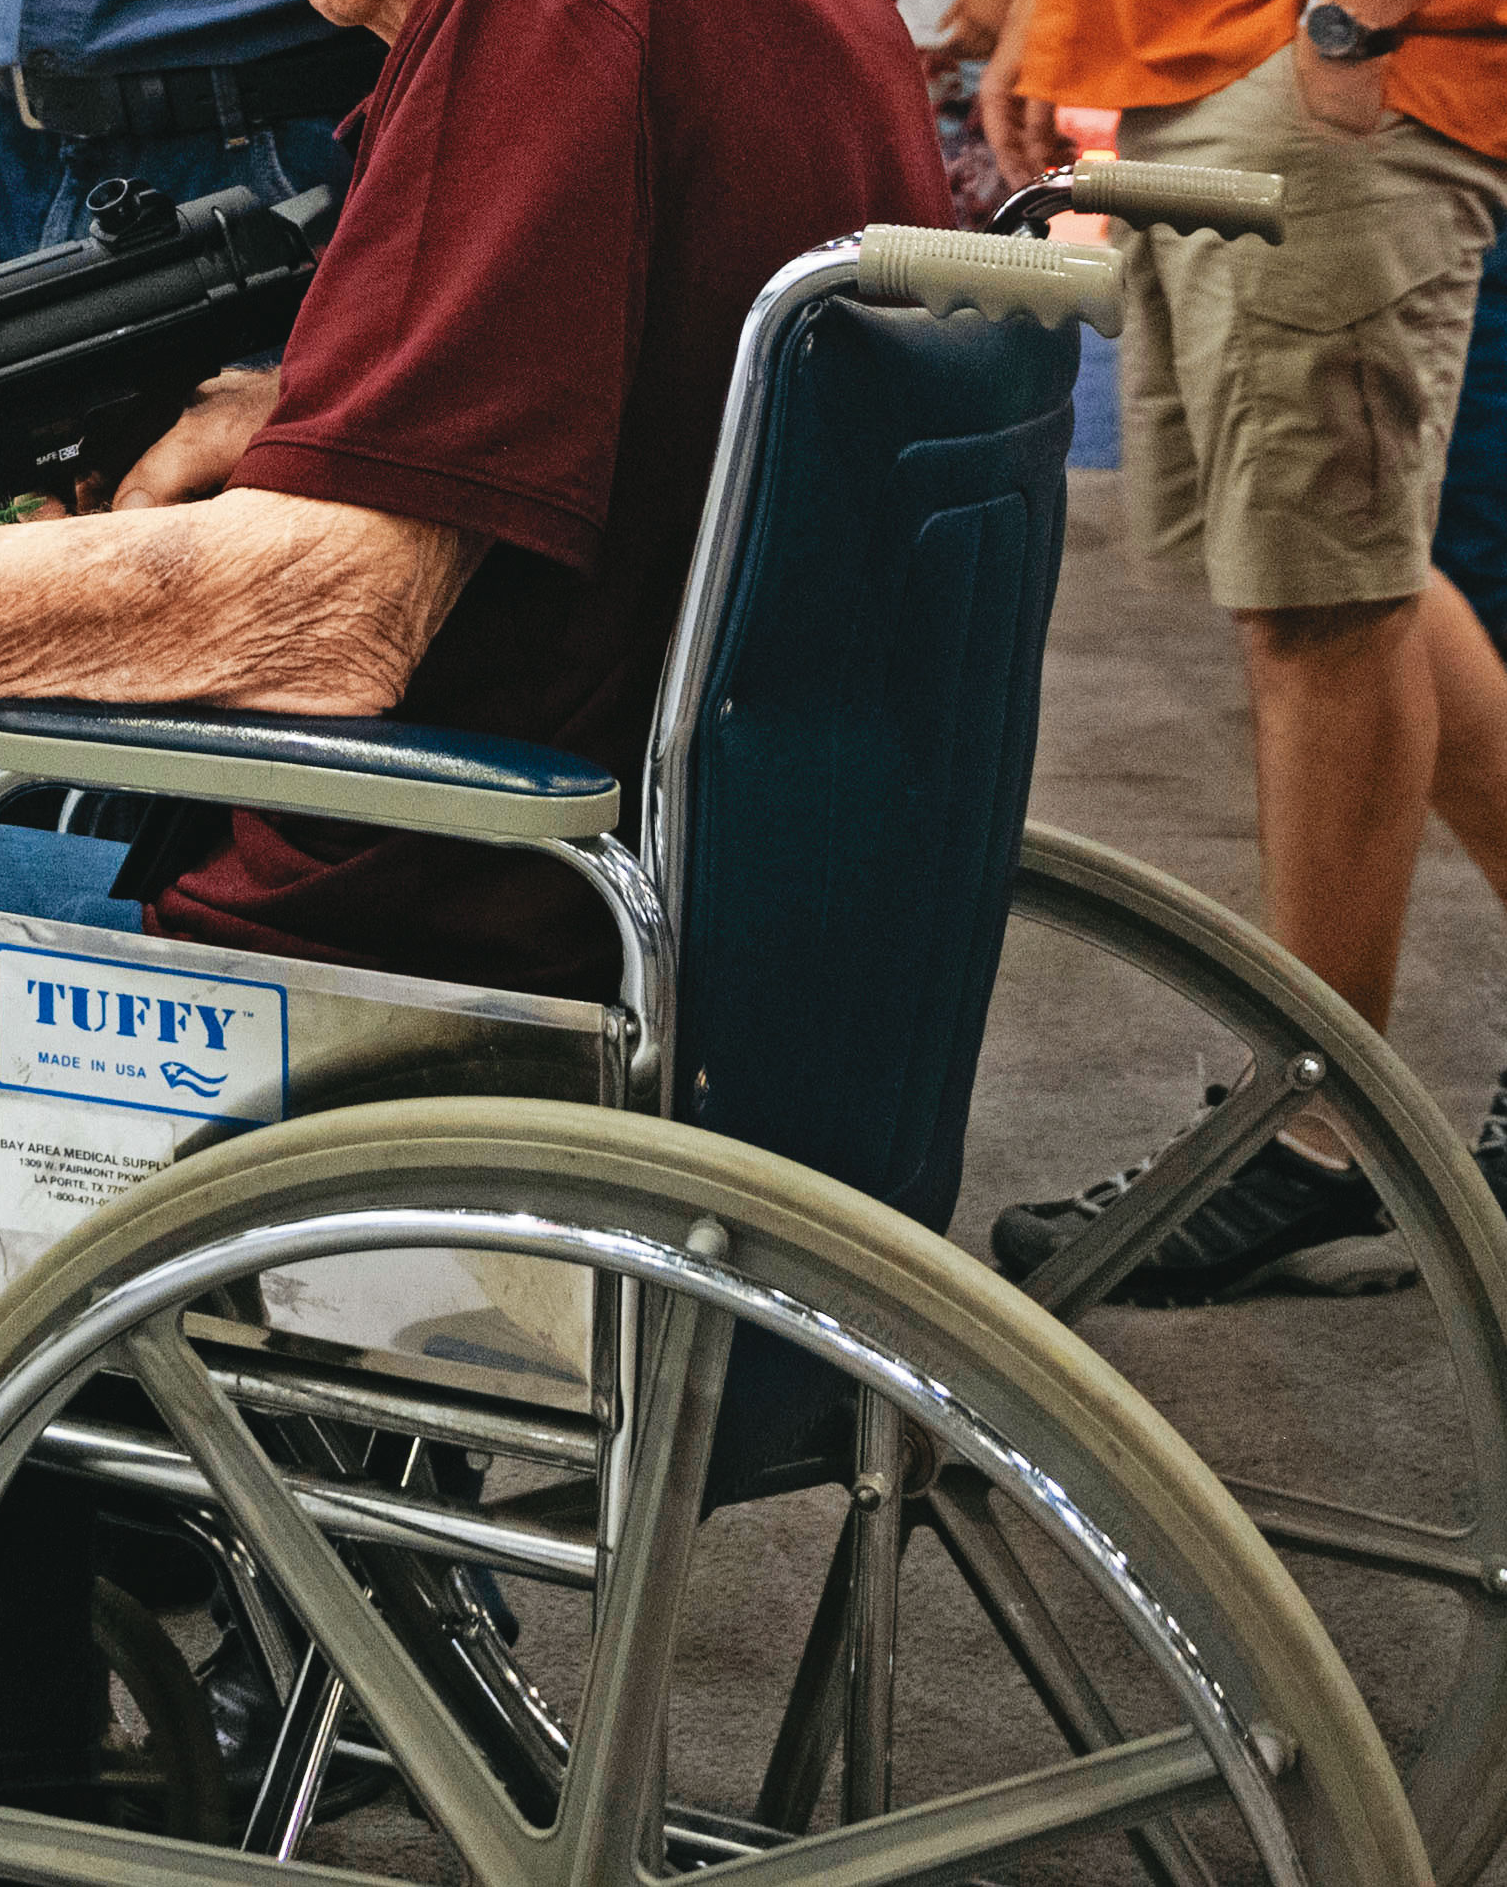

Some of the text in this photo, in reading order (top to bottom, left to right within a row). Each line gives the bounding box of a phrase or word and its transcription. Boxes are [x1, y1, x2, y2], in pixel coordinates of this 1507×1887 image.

[35, 451, 58, 466] SAFE
[27, 979, 236, 1051] TUFFY
[37, 1051, 147, 1079] MADE IN USA
[0, 1138, 24, 1151] BAY
[27, 1143, 61, 1157] AREA
[64, 1147, 118, 1166] MEDICAL
[20, 1157, 42, 1169] 1309
[44, 1161, 58, 1171] W.
[59, 1163, 114, 1180] FAIRMONT
[34, 1174, 48, 1184] LA
[50, 1176, 87, 1190] PORTE,
[91, 1182, 103, 1192] TX
[47, 1190, 110, 1207] 1-800-471-0
